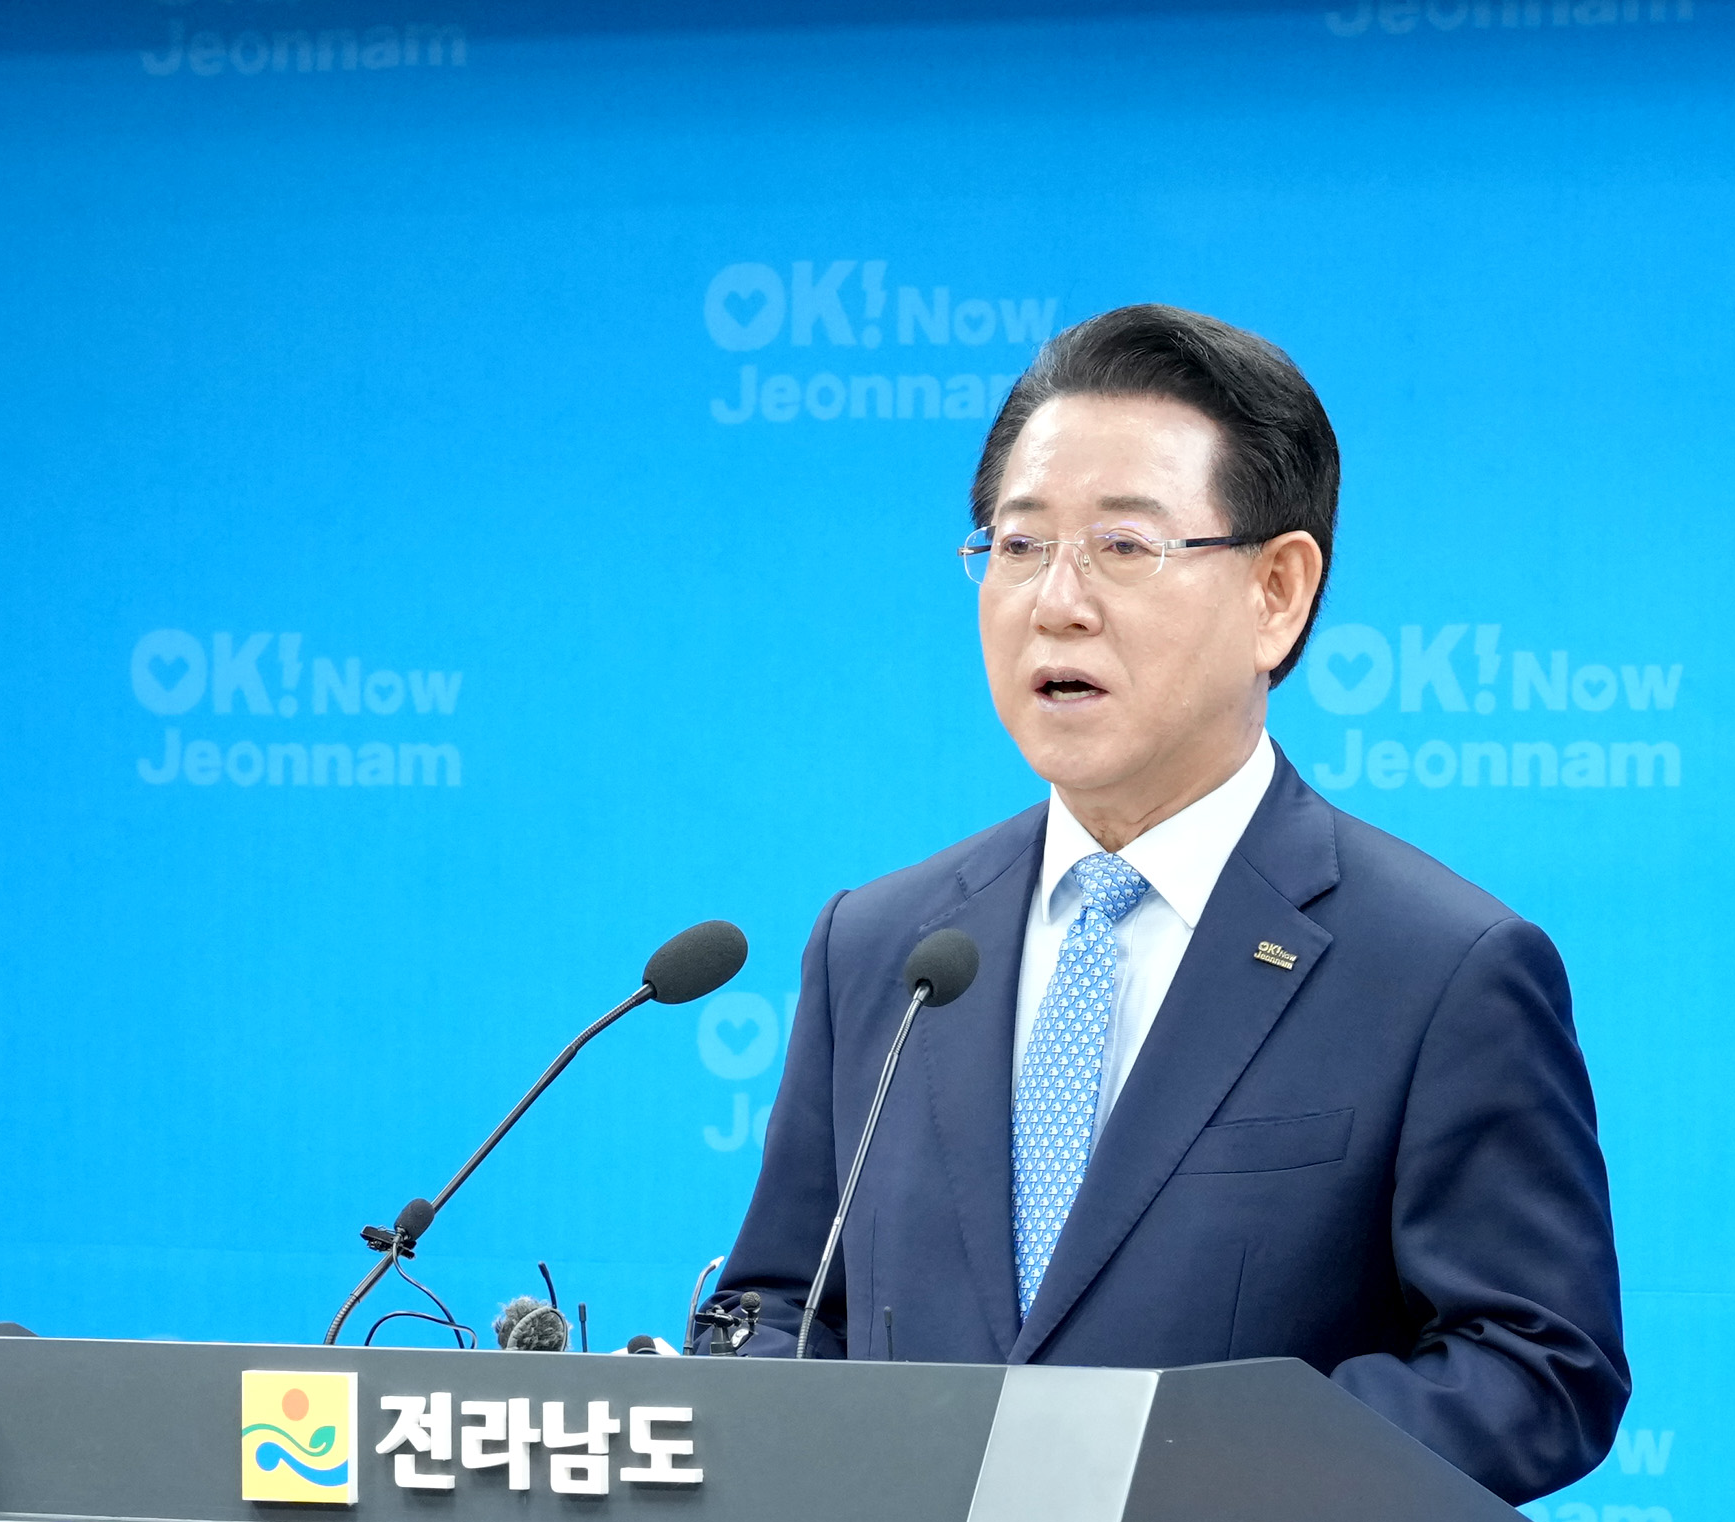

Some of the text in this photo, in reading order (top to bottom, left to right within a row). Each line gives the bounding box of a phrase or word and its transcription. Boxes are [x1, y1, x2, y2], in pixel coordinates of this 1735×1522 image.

[138, 16, 469, 77] Jeonnam
[898, 286, 1057, 345] Now
[311, 654, 464, 716] Now
[1513, 650, 1684, 712] Now
[138, 728, 461, 788] Jeonnam
[1314, 729, 1682, 791] Jeonnam
[1253, 951, 1294, 970] Jeonnam
[375, 1392, 704, 1495] 전라남도
